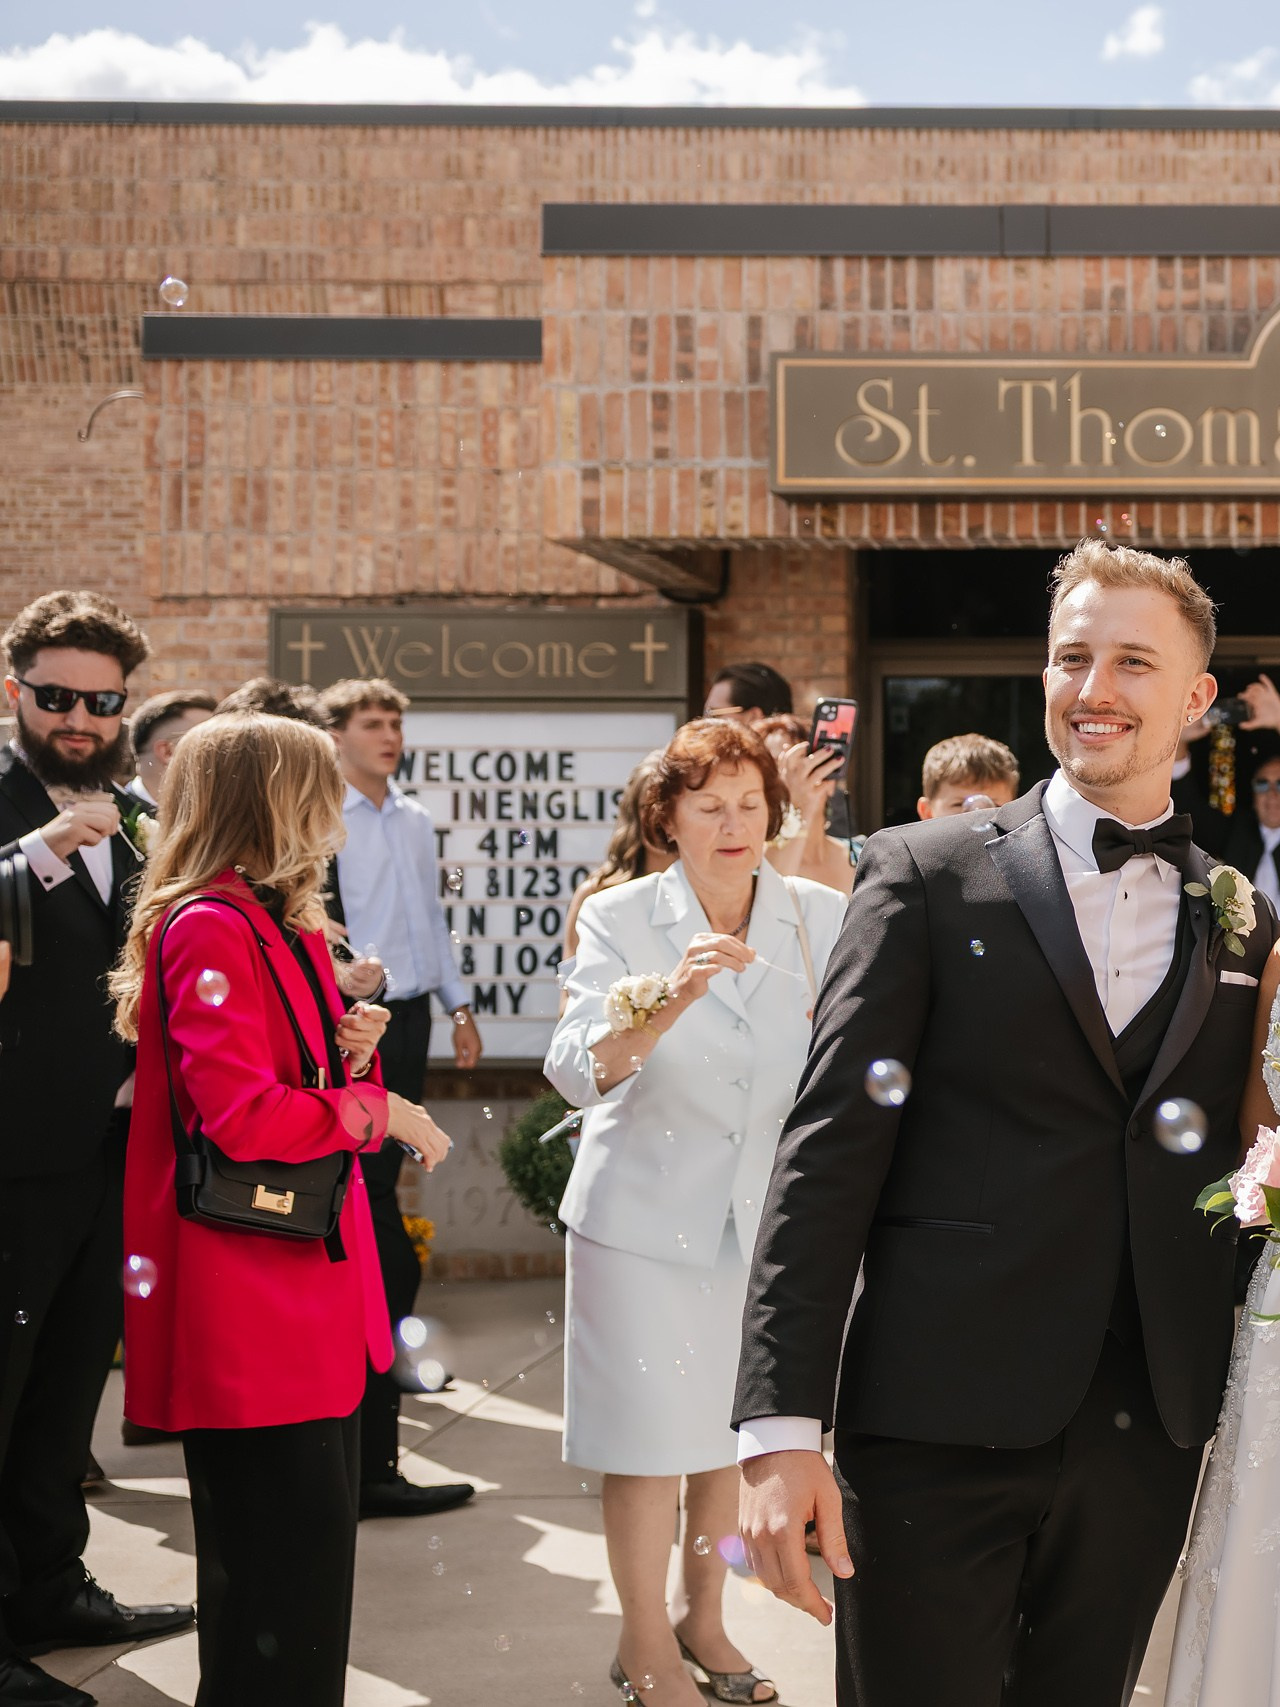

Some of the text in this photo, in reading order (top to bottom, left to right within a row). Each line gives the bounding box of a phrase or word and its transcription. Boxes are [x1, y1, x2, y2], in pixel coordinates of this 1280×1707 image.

[835, 377, 976, 468] St.
[342, 623, 618, 679] Welcome
[394, 751, 575, 782] WELCOME
[452, 789, 626, 820] INENGLIS
[435, 828, 558, 859] T 4PM
[440, 868, 463, 899] M
[514, 906, 561, 936] PO
[445, 1186, 528, 1227] 197
